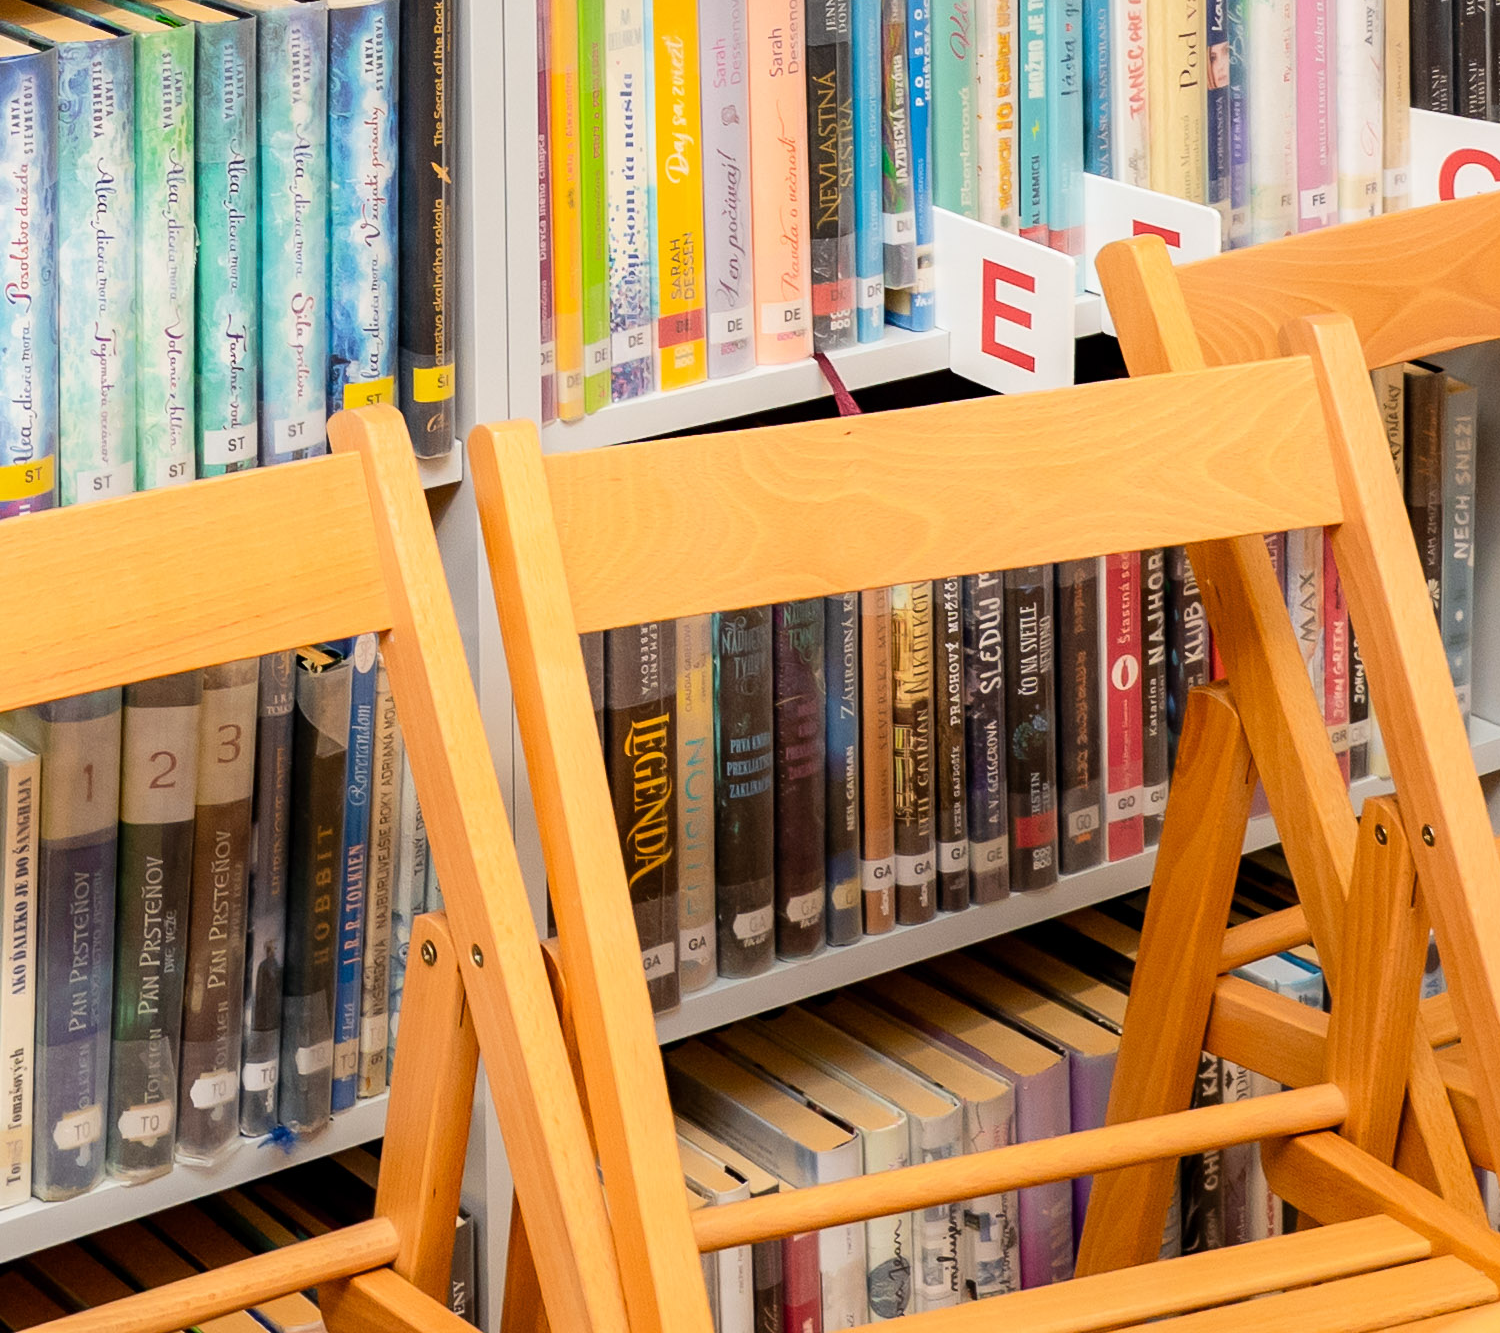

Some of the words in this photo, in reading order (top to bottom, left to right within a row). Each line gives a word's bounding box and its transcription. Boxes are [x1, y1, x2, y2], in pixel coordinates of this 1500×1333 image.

[980, 259, 1037, 373] E
[149, 751, 176, 789] 2
[218, 724, 241, 763] 3
[347, 703, 372, 807] Roverandom
